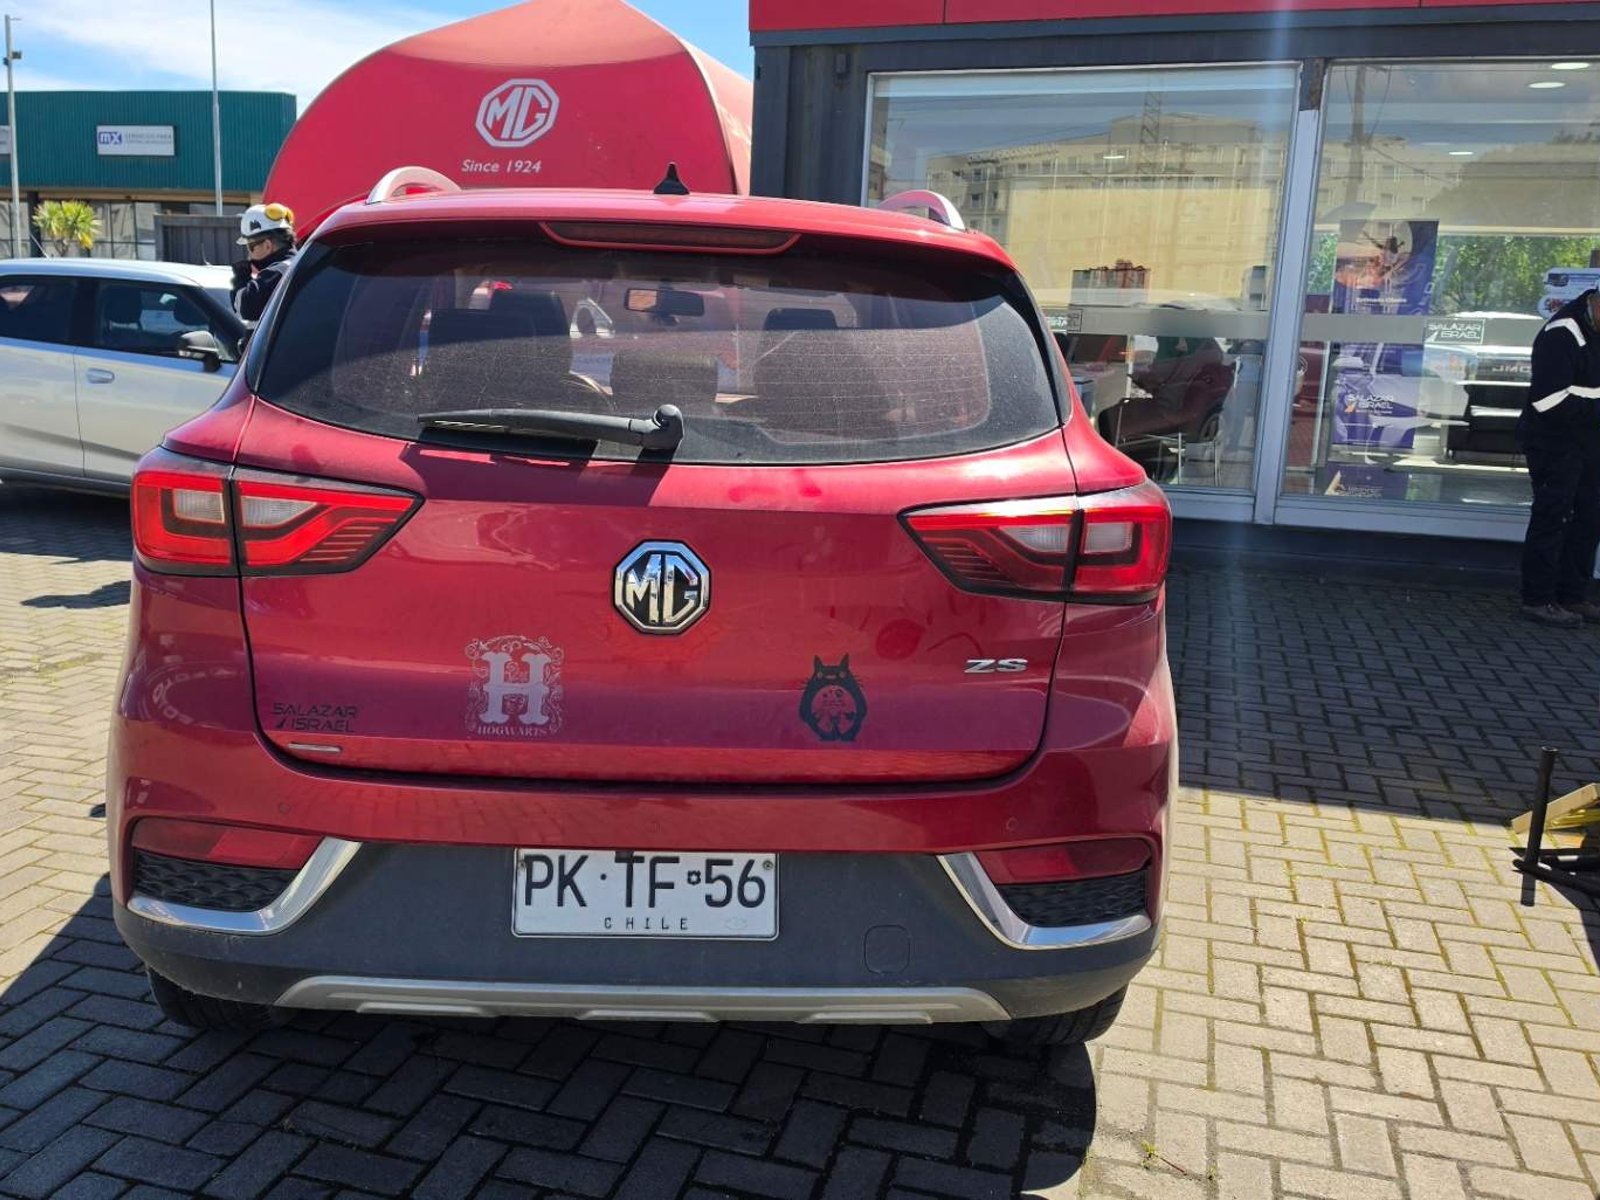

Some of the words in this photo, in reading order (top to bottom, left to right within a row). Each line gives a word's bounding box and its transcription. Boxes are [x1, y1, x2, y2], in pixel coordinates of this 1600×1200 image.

[485, 86, 549, 140] MG
[461, 158, 500, 173] Since
[505, 159, 542, 174] 1924
[1428, 322, 1482, 332] SALAZAR
[624, 552, 699, 624] MG
[963, 658, 1029, 674] ZS
[478, 651, 551, 725] H
[272, 701, 360, 718] SALAZAR
[290, 717, 356, 734] ISRAEL
[477, 725, 548, 738] HOGWARTS
[603, 916, 689, 931] CHILE
